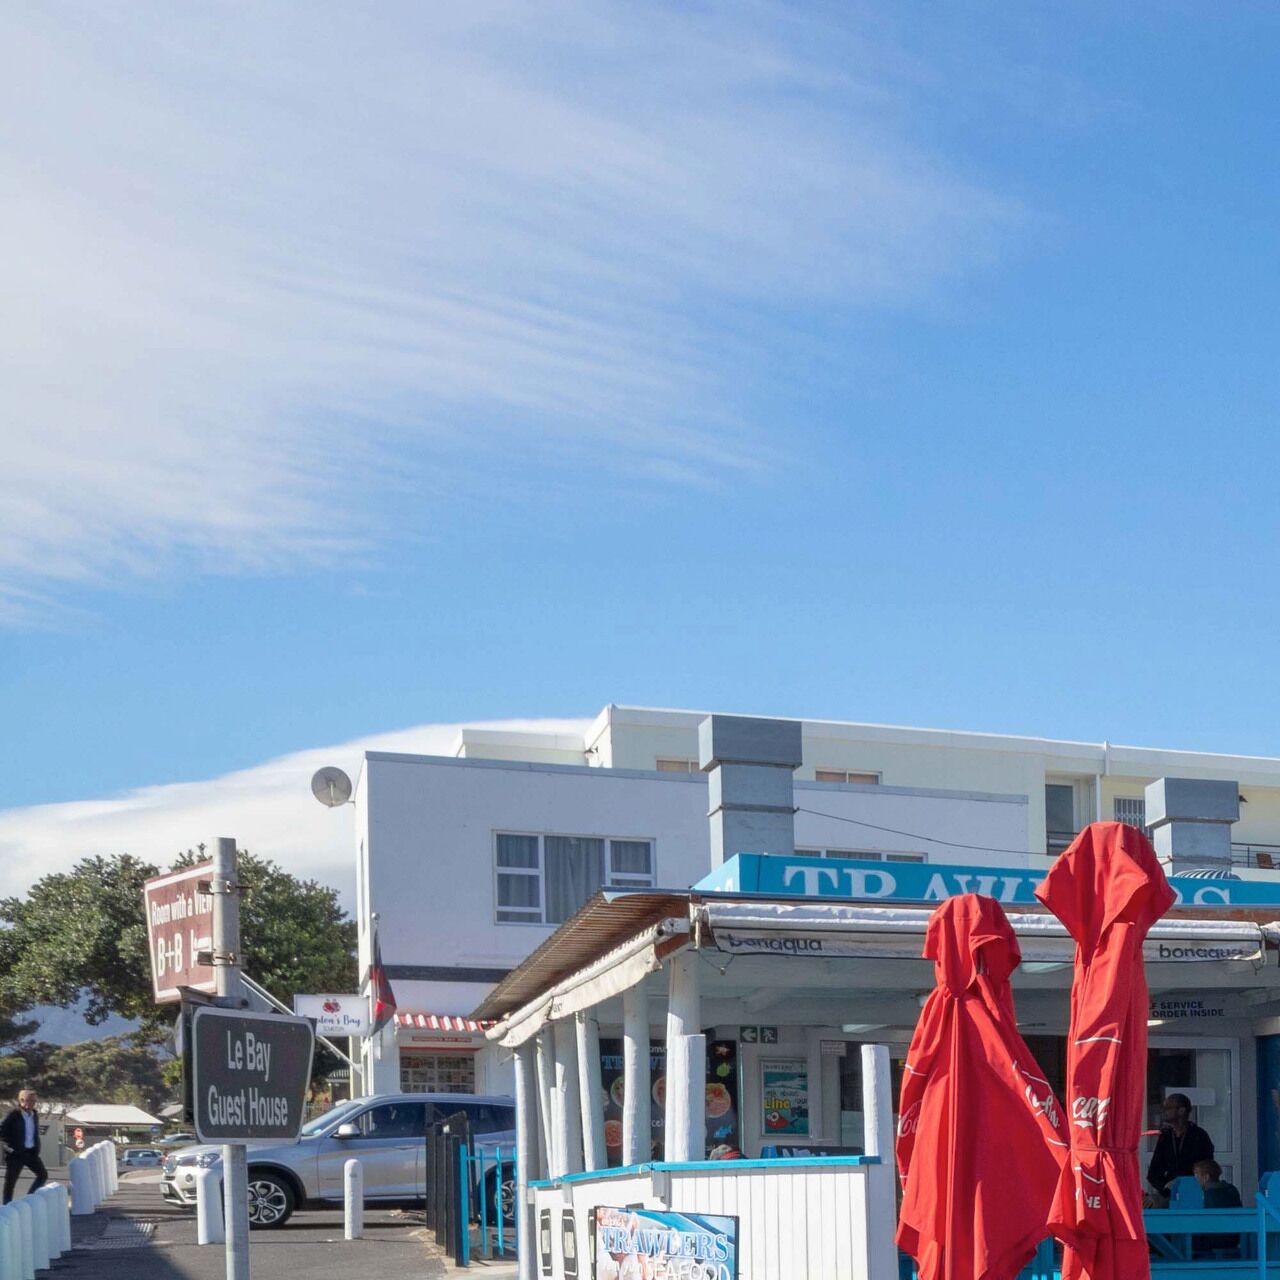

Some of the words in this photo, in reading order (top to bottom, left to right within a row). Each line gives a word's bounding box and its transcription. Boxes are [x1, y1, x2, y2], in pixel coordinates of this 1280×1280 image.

[151, 900, 170, 927] Room
[170, 894, 187, 920] with
[1152, 1010, 1187, 1018] ORDER
[1190, 1009, 1224, 1018] INSIDE
[1161, 1001, 1204, 1010] SERVICE
[227, 1030, 243, 1070] Le
[245, 1032, 271, 1082] Bay
[207, 1085, 247, 1127] Guest
[249, 1087, 289, 1127] House
[600, 1224, 730, 1262] TRAWLERS
